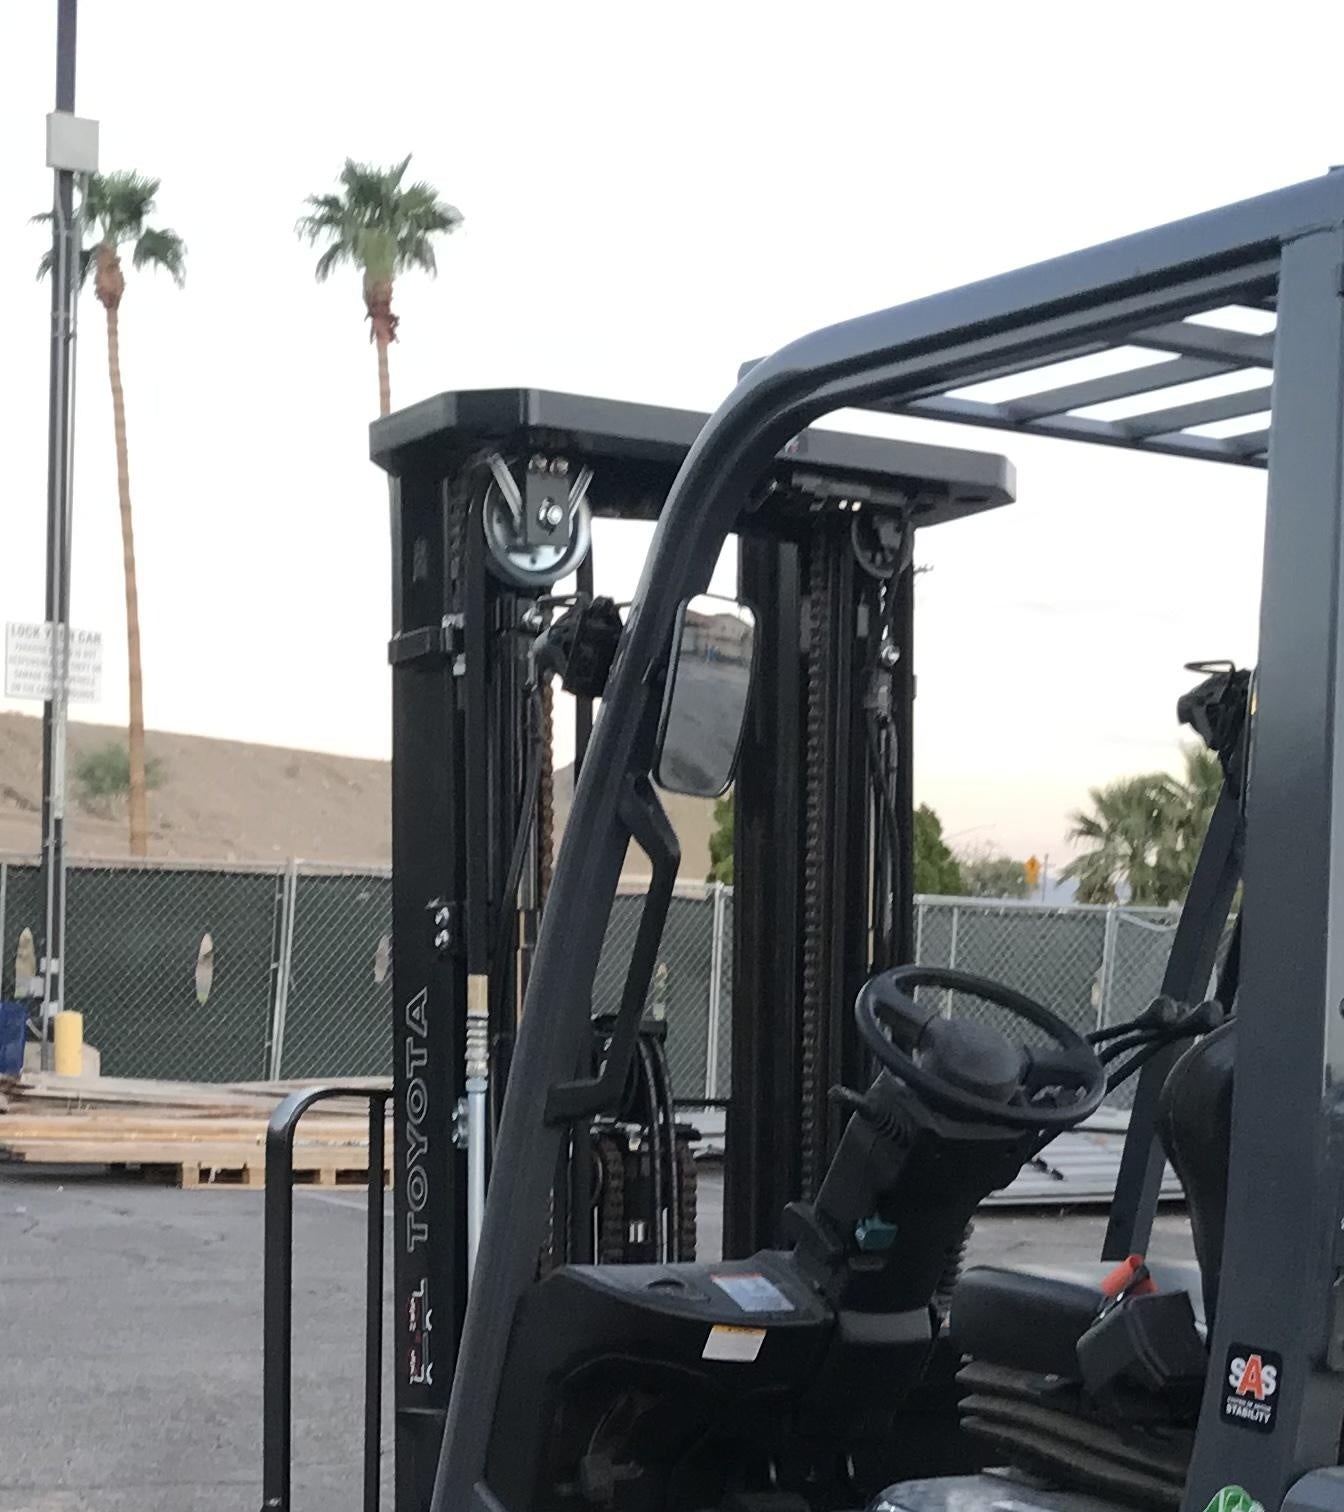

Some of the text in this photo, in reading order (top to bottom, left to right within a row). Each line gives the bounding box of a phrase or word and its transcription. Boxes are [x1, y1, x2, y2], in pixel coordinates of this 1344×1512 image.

[405, 987, 429, 1253] TOYOTA
[1228, 1353, 1278, 1400] SAS
[1225, 1403, 1272, 1424] STABILITY
